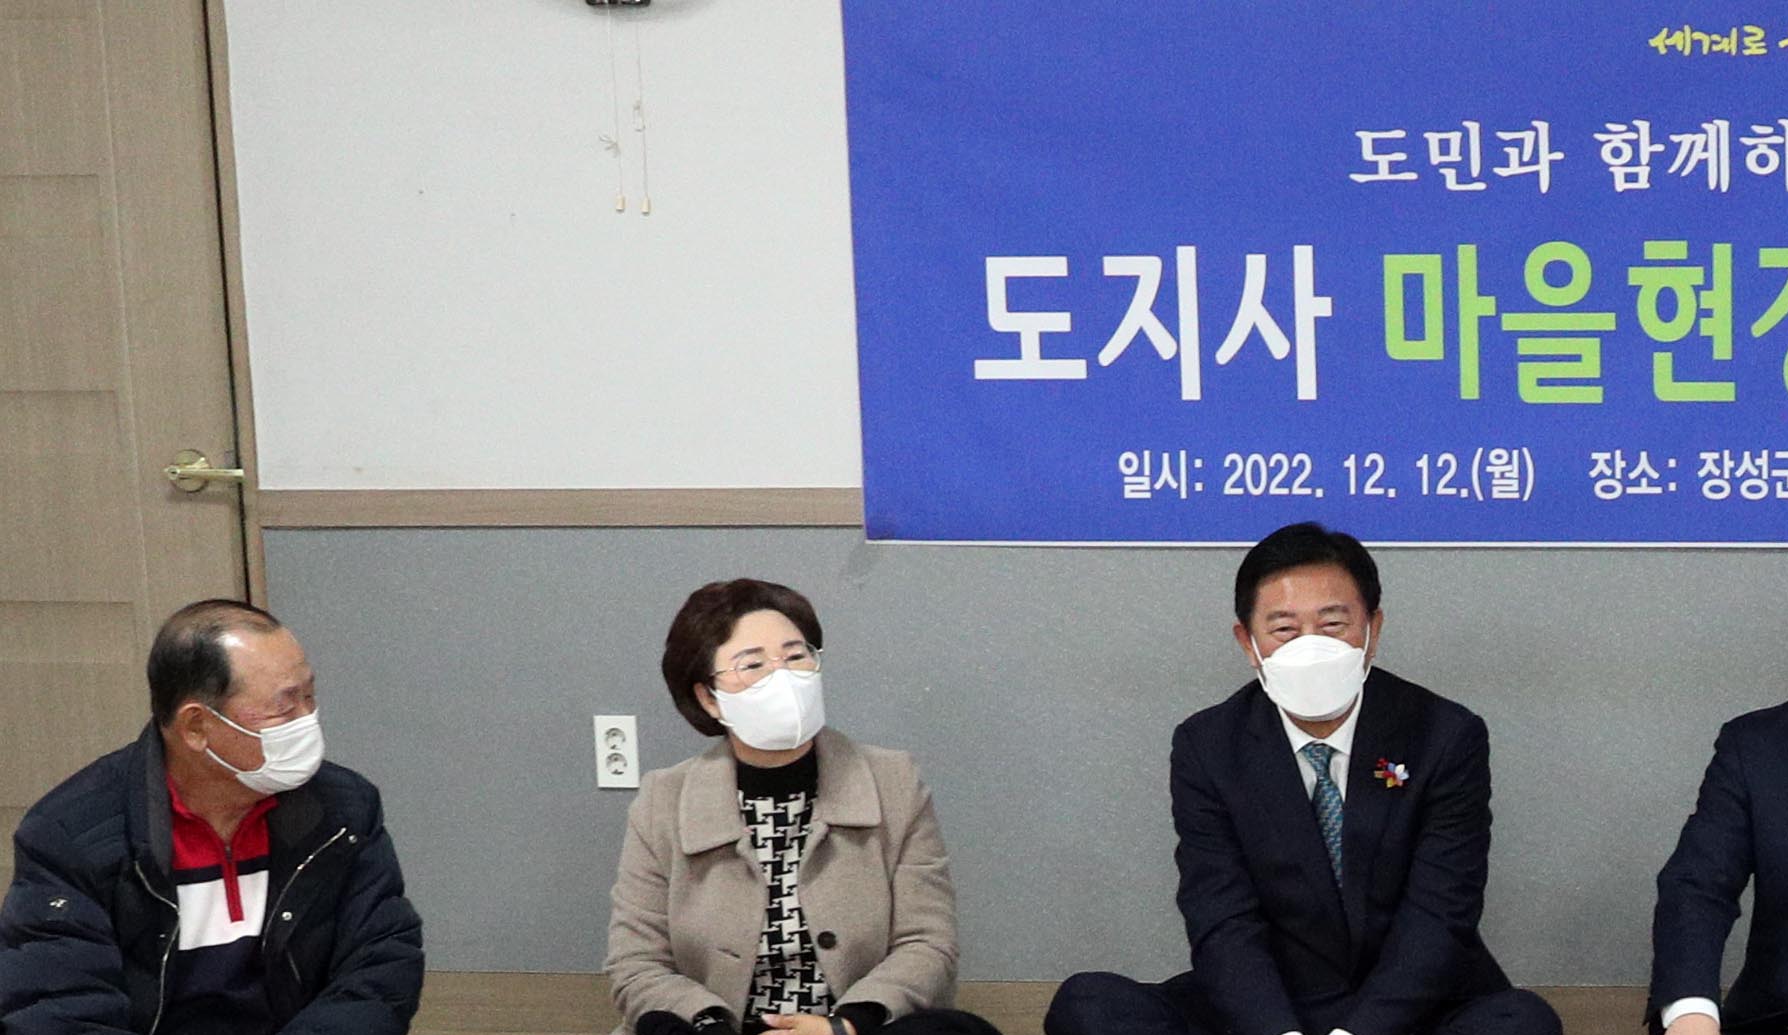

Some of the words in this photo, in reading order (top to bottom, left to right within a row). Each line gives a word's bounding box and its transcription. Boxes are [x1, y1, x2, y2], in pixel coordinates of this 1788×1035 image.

[1648, 24, 1768, 57] 세계로
[1348, 120, 1565, 194] 도민과
[973, 244, 1333, 401] 도지사
[1118, 449, 1203, 500] 일시:
[1223, 452, 1324, 498] 2022.
[1343, 452, 1396, 498] 12.
[1415, 446, 1535, 502] 12.(월)
[1588, 449, 1677, 500] 장소:
